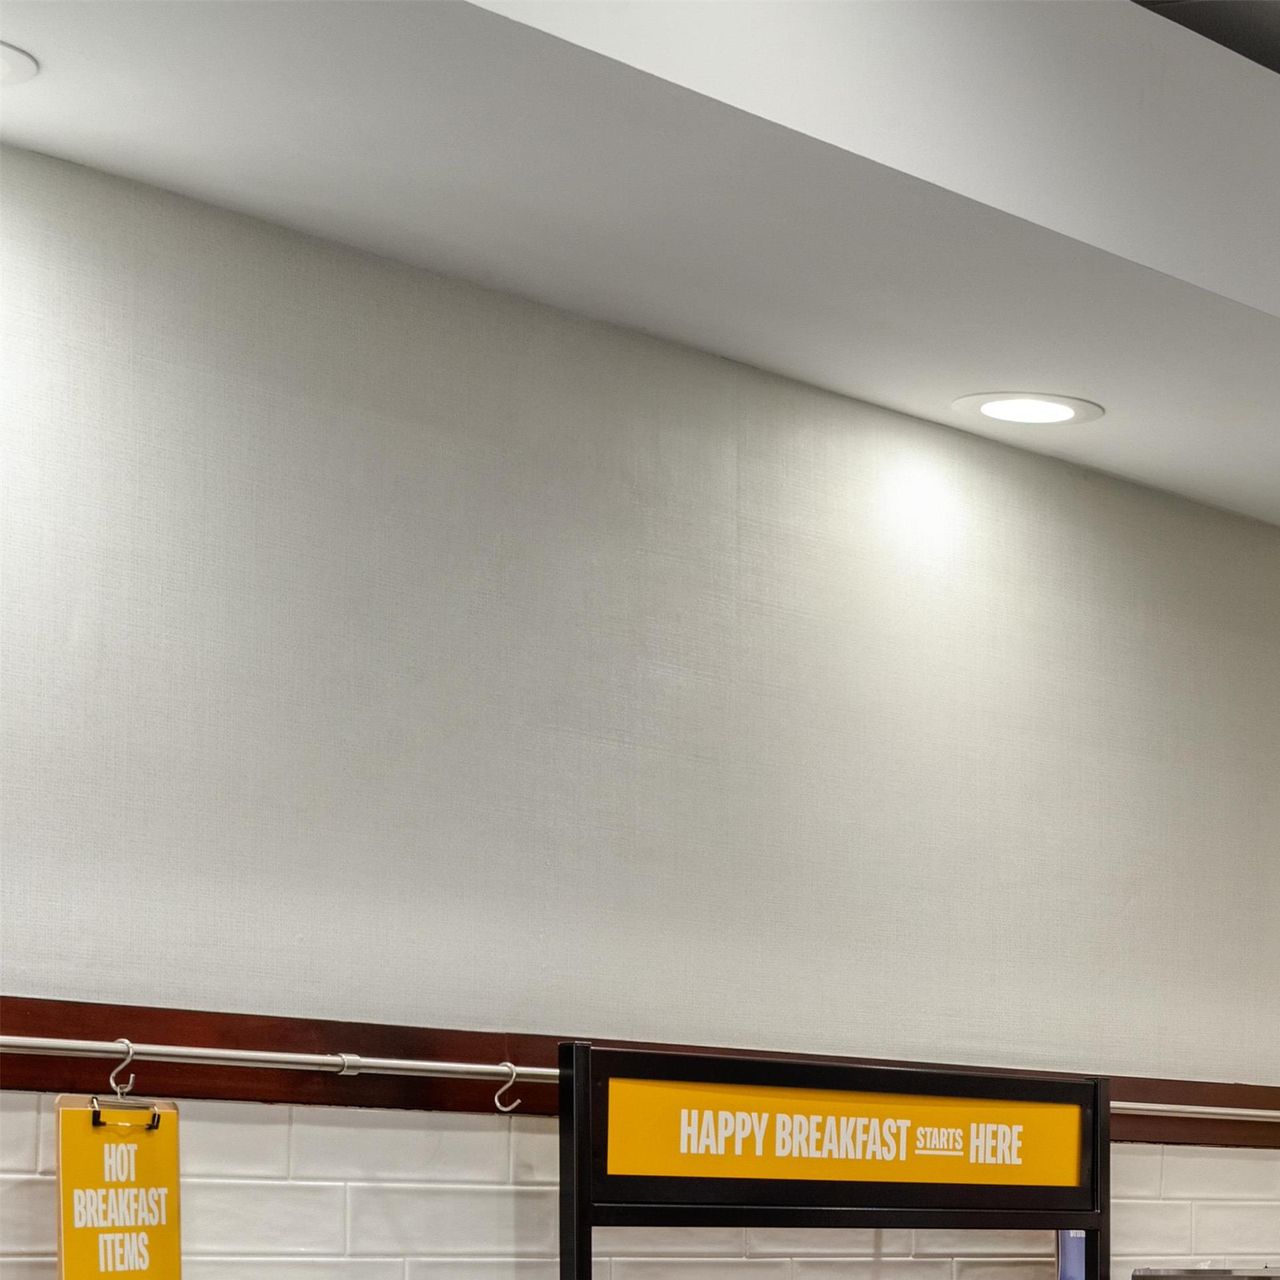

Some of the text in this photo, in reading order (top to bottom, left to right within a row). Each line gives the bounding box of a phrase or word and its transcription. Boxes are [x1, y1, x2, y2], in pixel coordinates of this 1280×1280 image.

[680, 1108, 1024, 1166] HAPPY BREAKFAST STARTS HERE
[103, 1143, 138, 1183] HOT
[73, 1187, 169, 1229] BREAKFAST
[98, 1232, 150, 1273] ITEMS
